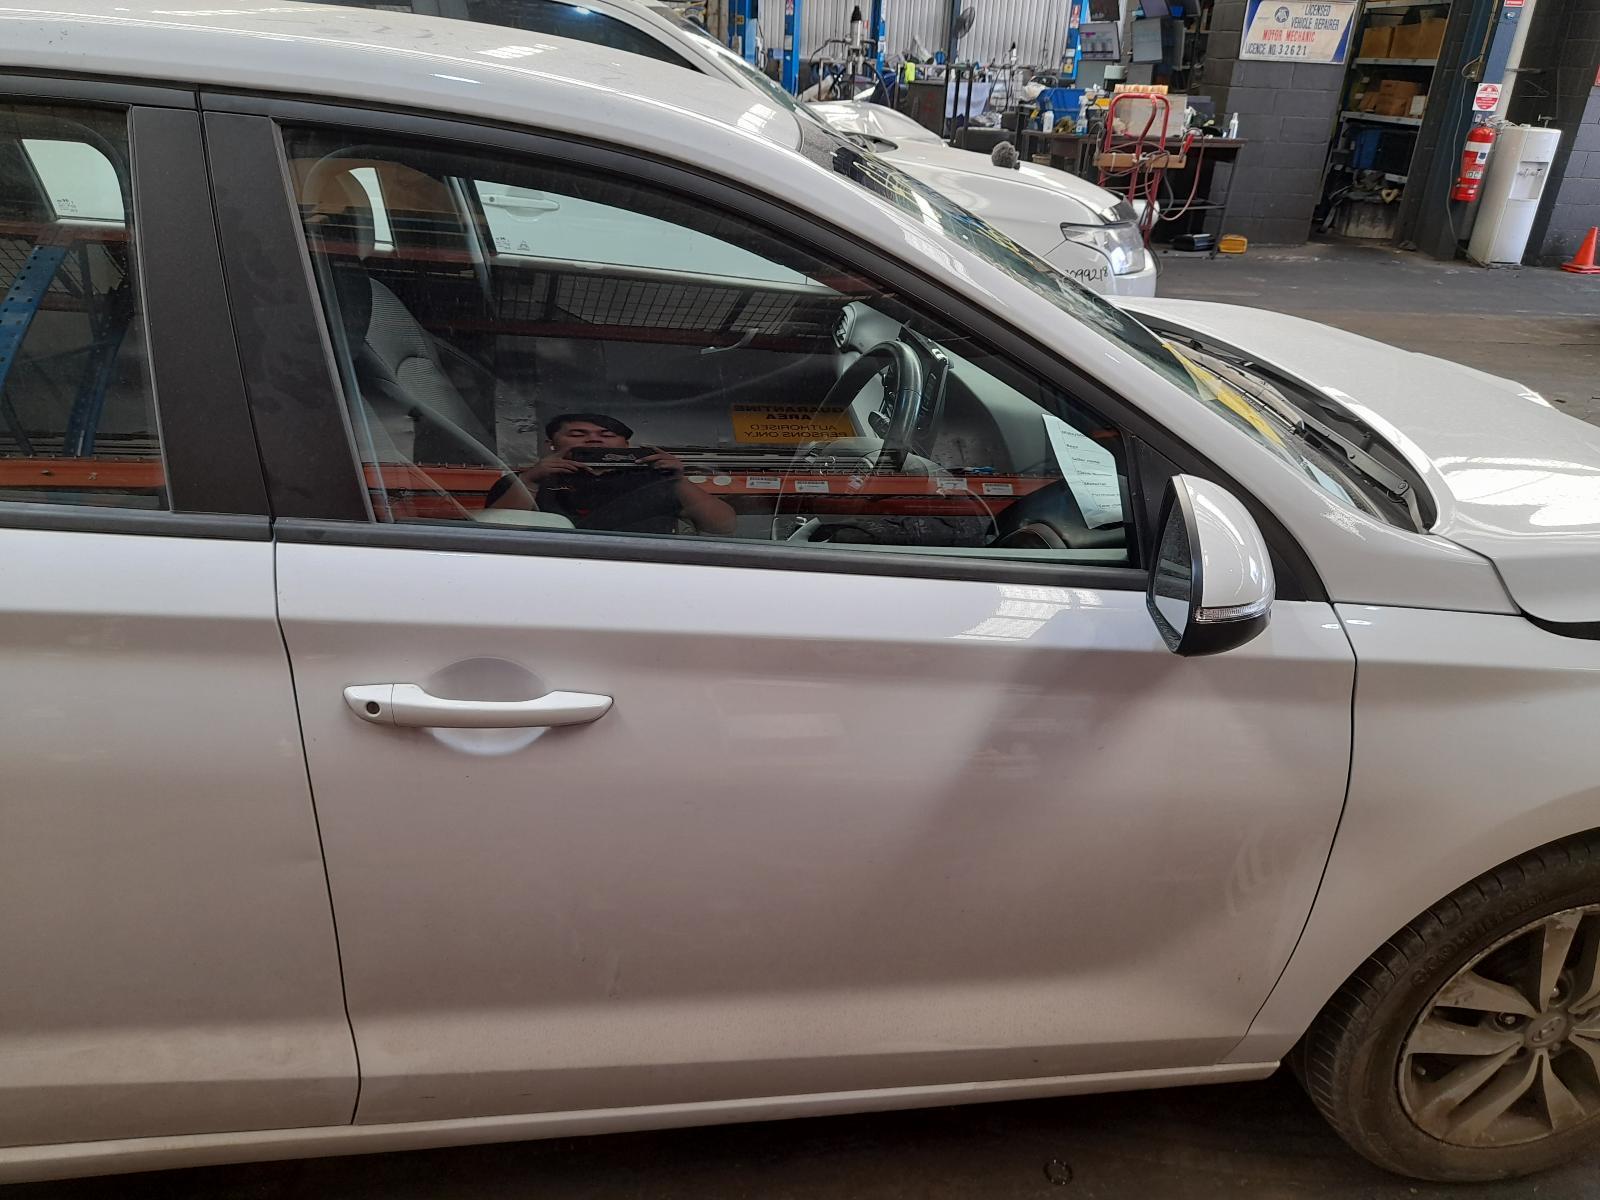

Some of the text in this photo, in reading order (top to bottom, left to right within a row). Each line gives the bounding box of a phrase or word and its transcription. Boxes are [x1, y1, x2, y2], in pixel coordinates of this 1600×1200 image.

[1304, 5, 1331, 17] LICENSED
[1291, 17, 1339, 31] VEHICLE REPAIRER
[1263, 30, 1316, 42] MOTOR MECHANIC
[1245, 43, 1266, 55] LICENCE
